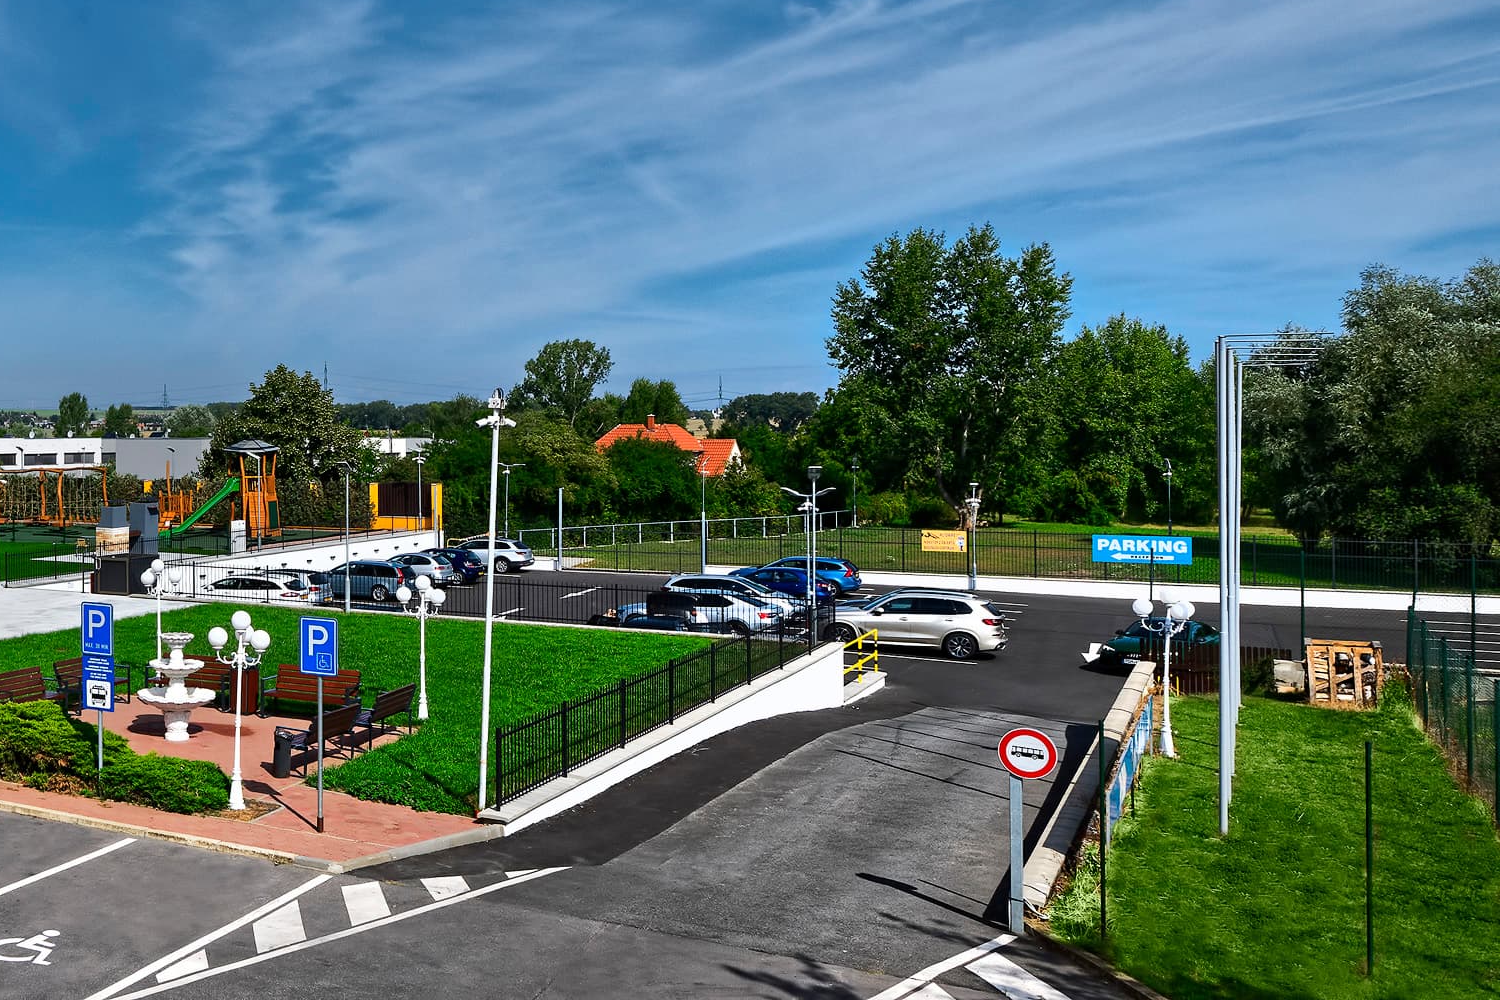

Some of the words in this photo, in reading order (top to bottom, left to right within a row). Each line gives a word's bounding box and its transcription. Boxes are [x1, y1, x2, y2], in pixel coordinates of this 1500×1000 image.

[1097, 538, 1188, 554] PARKING
[88, 609, 106, 638] P
[308, 624, 329, 656] P
